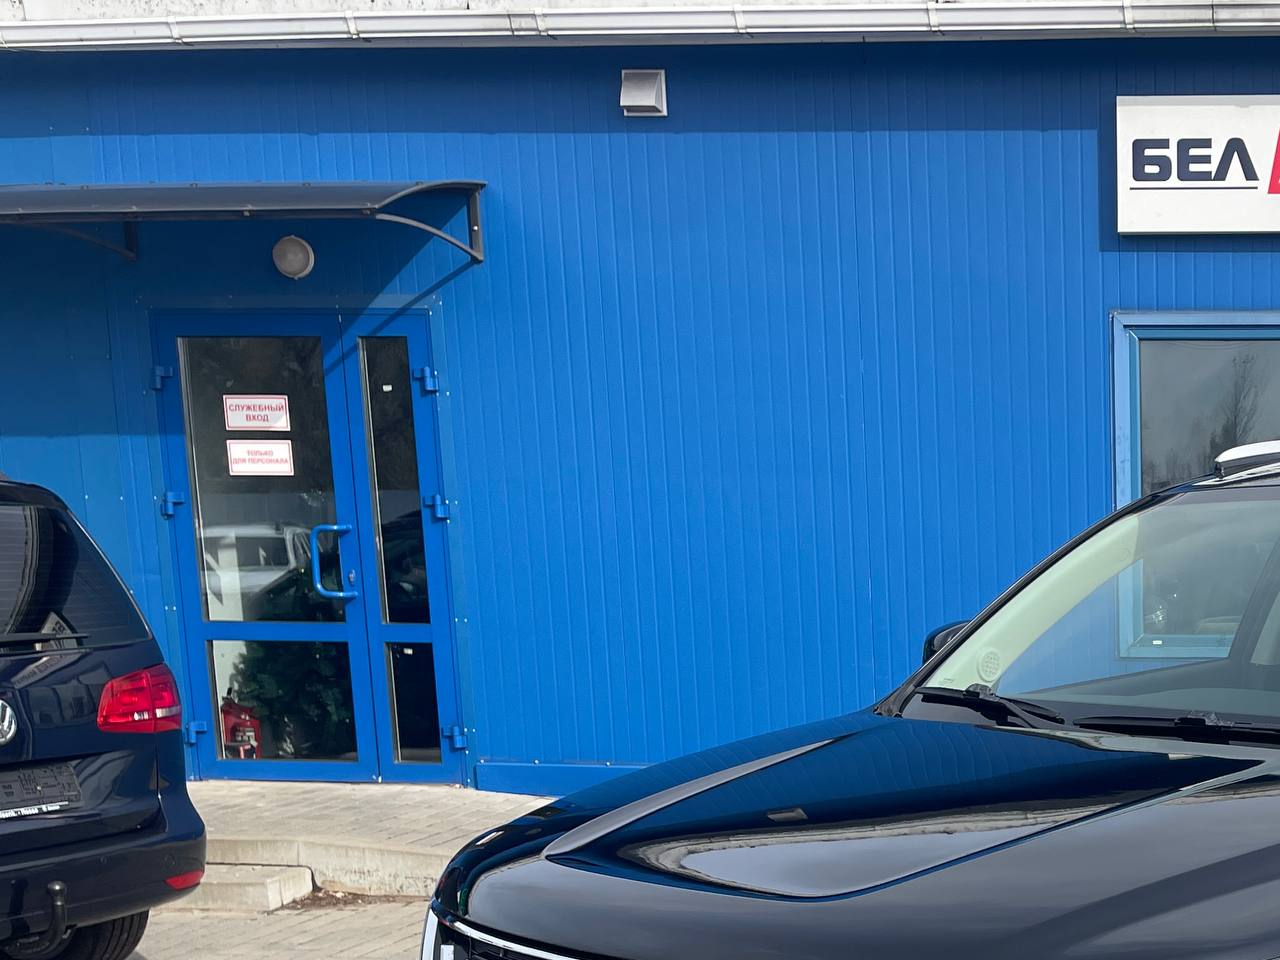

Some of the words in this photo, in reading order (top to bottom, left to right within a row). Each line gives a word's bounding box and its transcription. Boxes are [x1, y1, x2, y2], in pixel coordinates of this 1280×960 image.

[1130, 137, 1259, 182] БЕЛ
[228, 402, 285, 412] СЛУЖЕБНЫЙ
[245, 413, 269, 422] ВХОД
